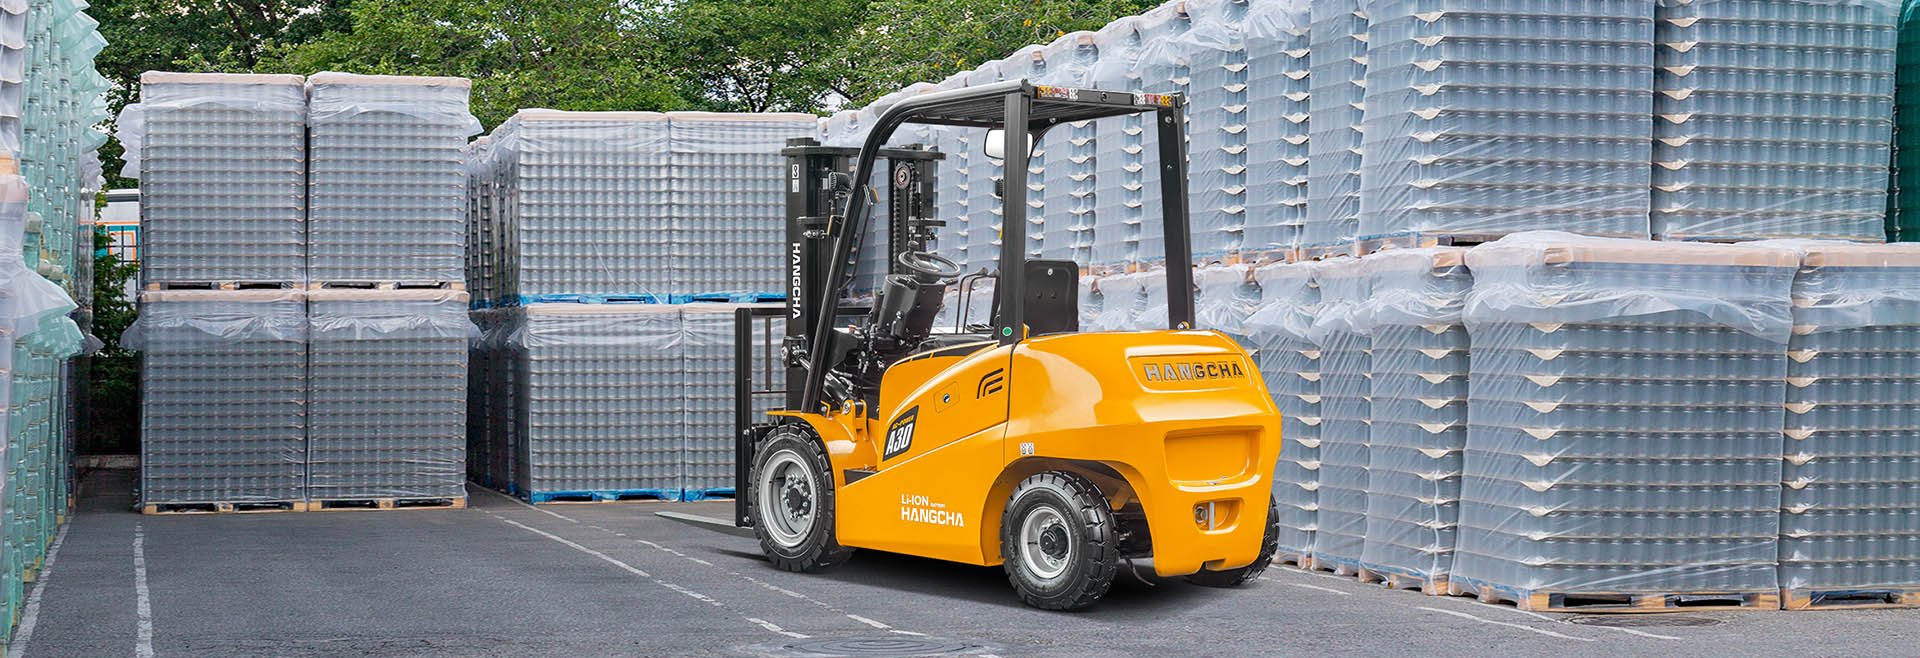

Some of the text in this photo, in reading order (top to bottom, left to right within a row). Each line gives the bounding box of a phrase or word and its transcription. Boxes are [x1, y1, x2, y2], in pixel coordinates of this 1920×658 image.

[792, 242, 801, 320] HANGCHA
[1143, 362, 1244, 381] HANGCHA
[885, 423, 913, 456] A30
[901, 506, 964, 527] HANGCHA
